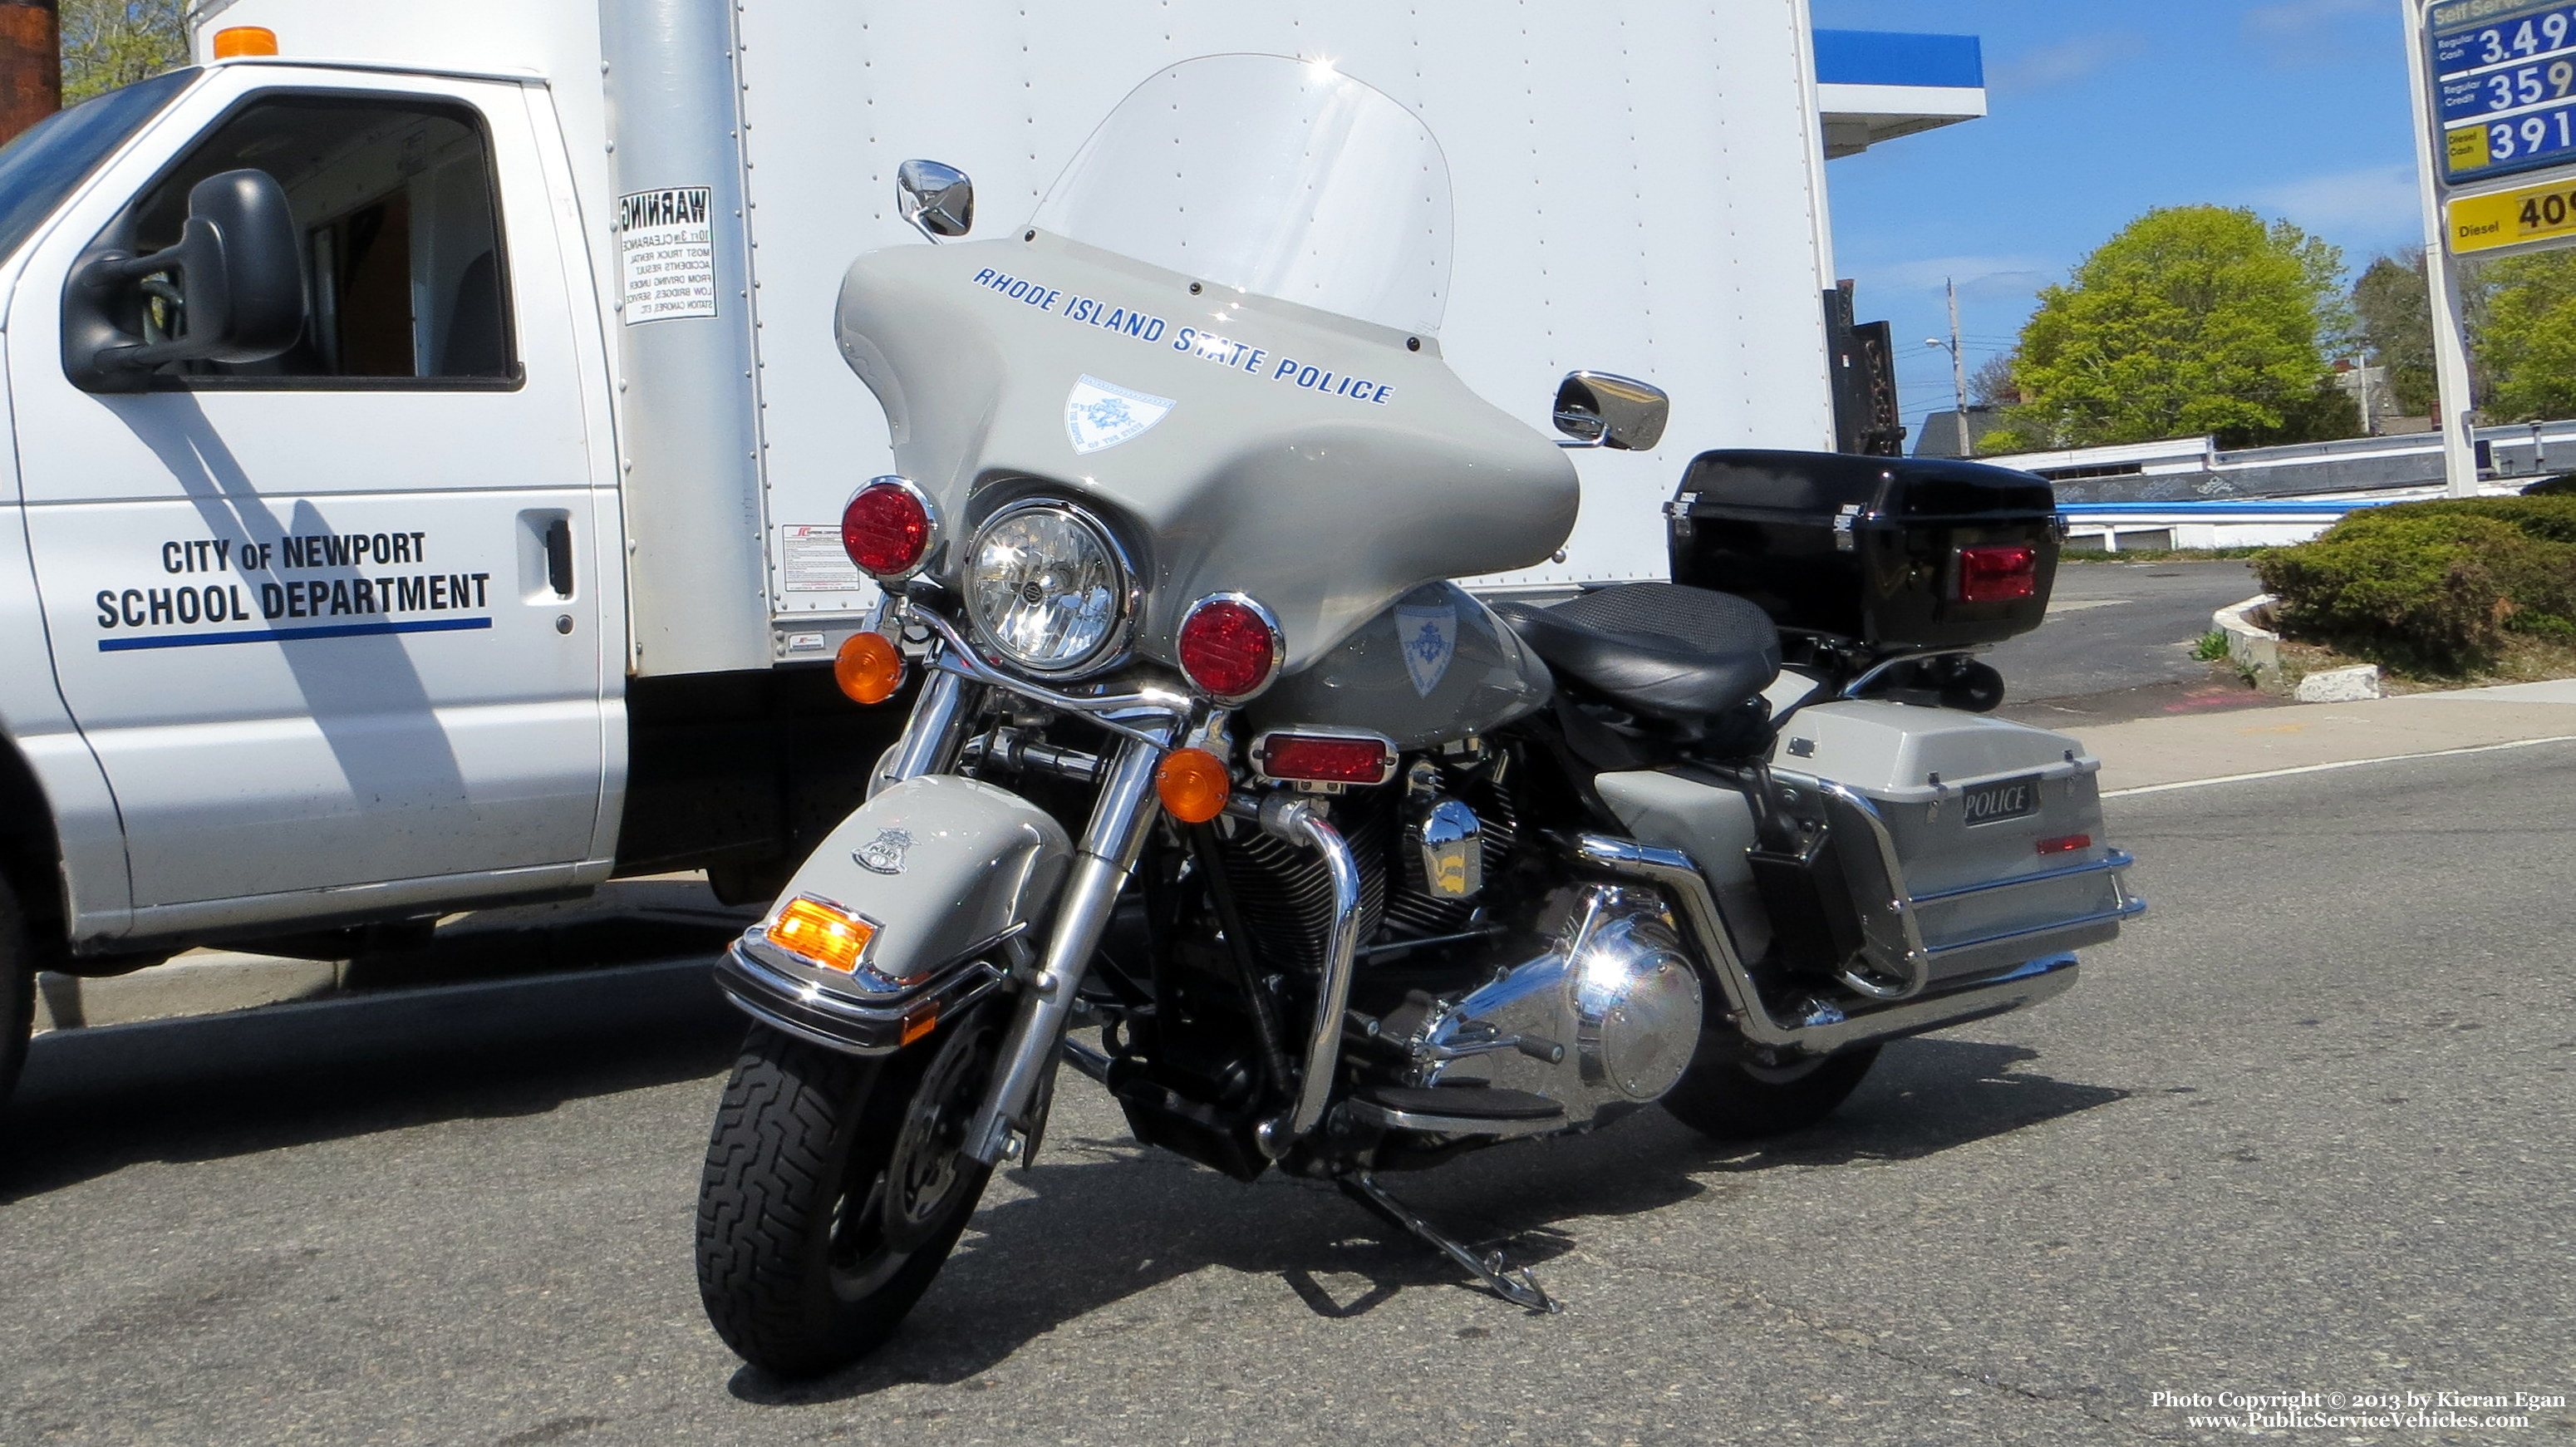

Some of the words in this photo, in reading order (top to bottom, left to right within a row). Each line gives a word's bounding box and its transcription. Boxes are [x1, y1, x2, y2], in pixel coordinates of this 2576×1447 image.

[2438, 34, 2475, 48] Regular
[2440, 49, 2465, 61] Cash
[2444, 81, 2481, 95] Regular
[2488, 61, 2574, 111] 359
[2445, 93, 2475, 107] Credit
[2448, 131, 2477, 145] Diesel
[2490, 111, 2570, 160] 391
[2449, 145, 2474, 157] Cash
[2460, 221, 2500, 238] Diesel
[972, 267, 1062, 312] RHODE
[1062, 295, 1166, 343] ISLAND
[1172, 327, 1267, 374] STATE
[1272, 357, 1395, 406] POLICE
[162, 539, 231, 573] CITY
[241, 543, 272, 570] OF
[282, 531, 426, 568] NEWPORT
[96, 584, 250, 628] SCHOOL
[261, 572, 490, 619] DEPARTMENT
[1964, 785, 2026, 819] POLICE
